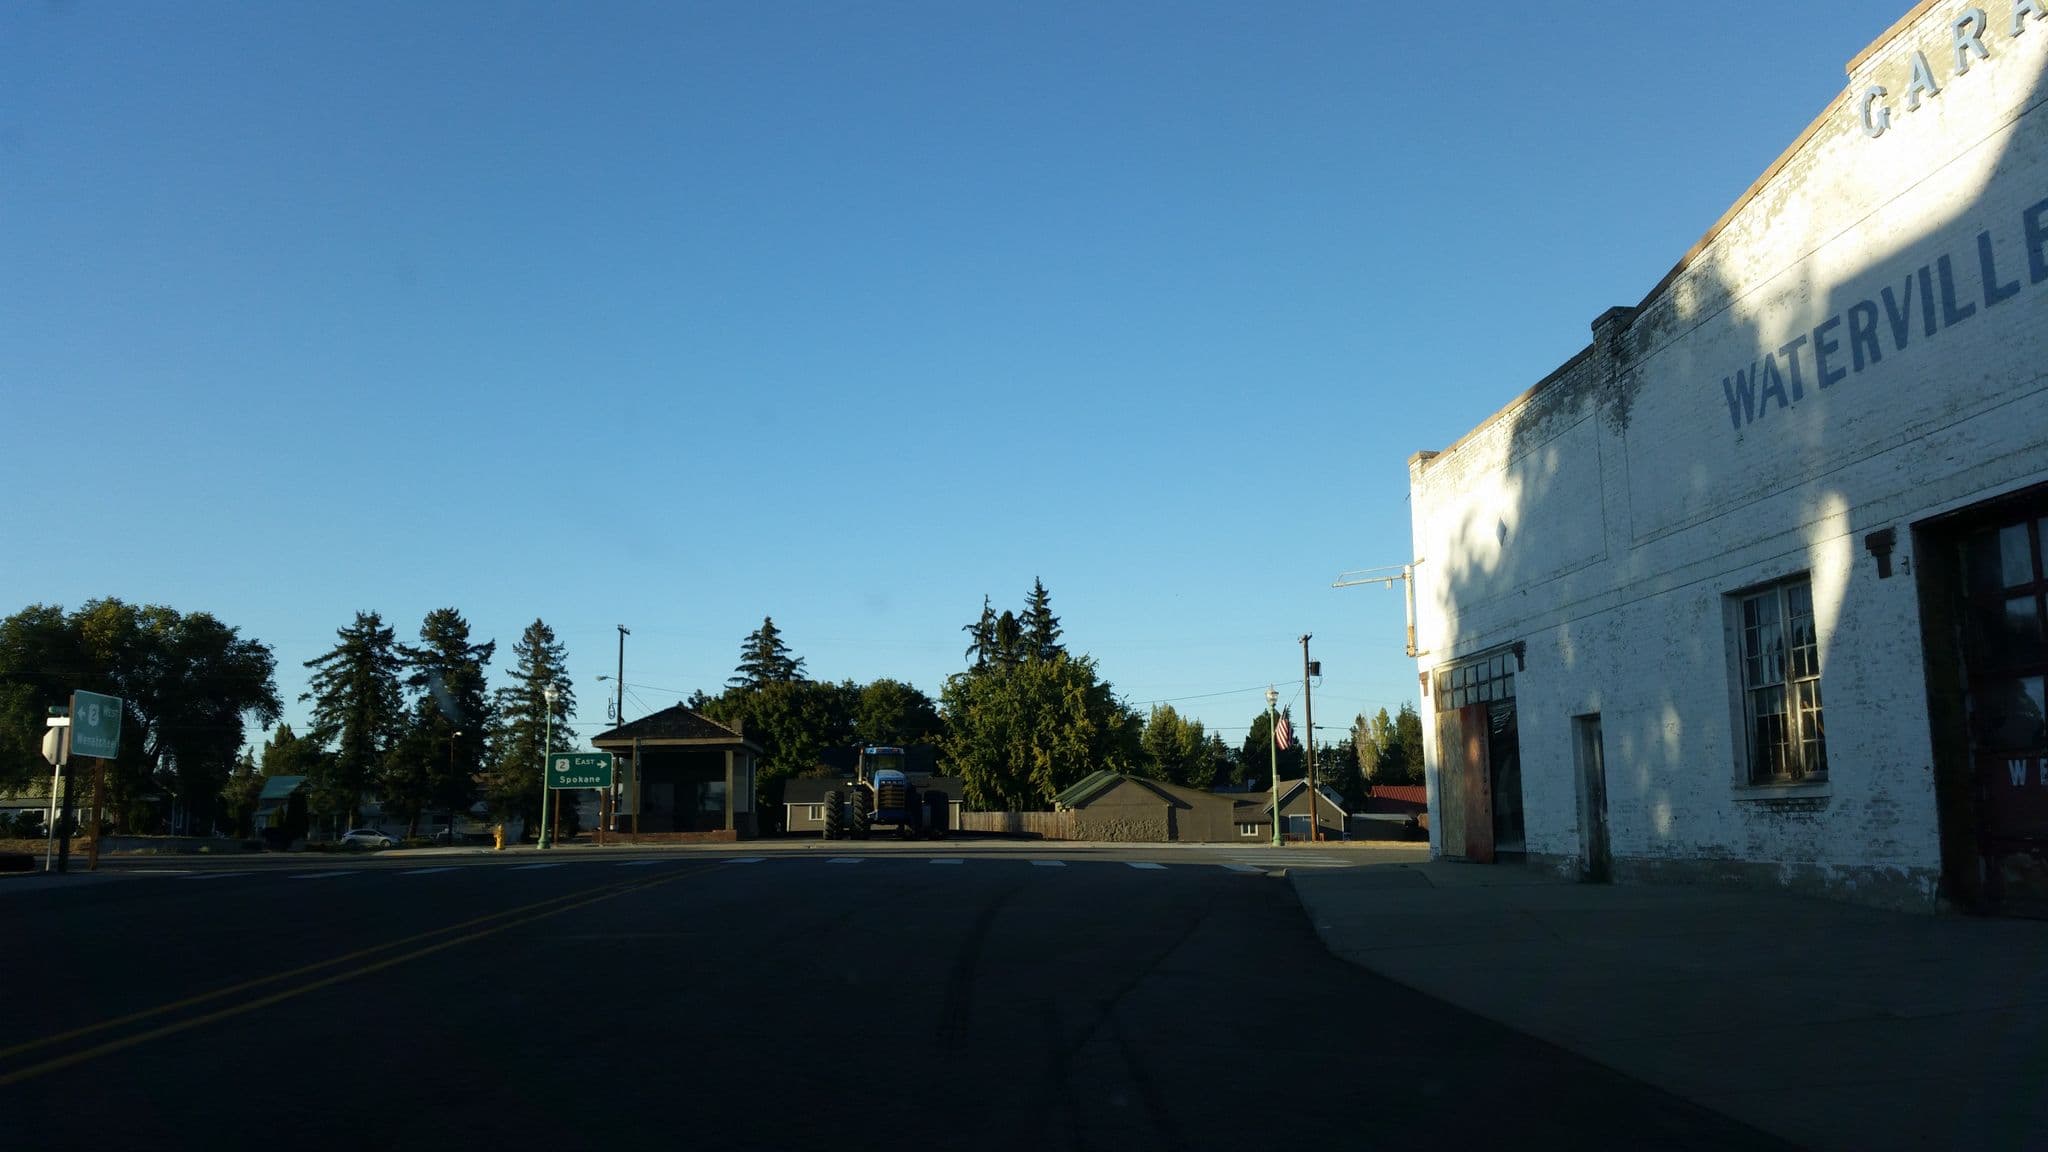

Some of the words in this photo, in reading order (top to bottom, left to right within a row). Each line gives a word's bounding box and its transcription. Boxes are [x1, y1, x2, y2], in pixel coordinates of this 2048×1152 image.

[1722, 198, 2048, 430] WATERVILLE
[559, 761, 566, 770] 2
[559, 775, 601, 785] Spokane
